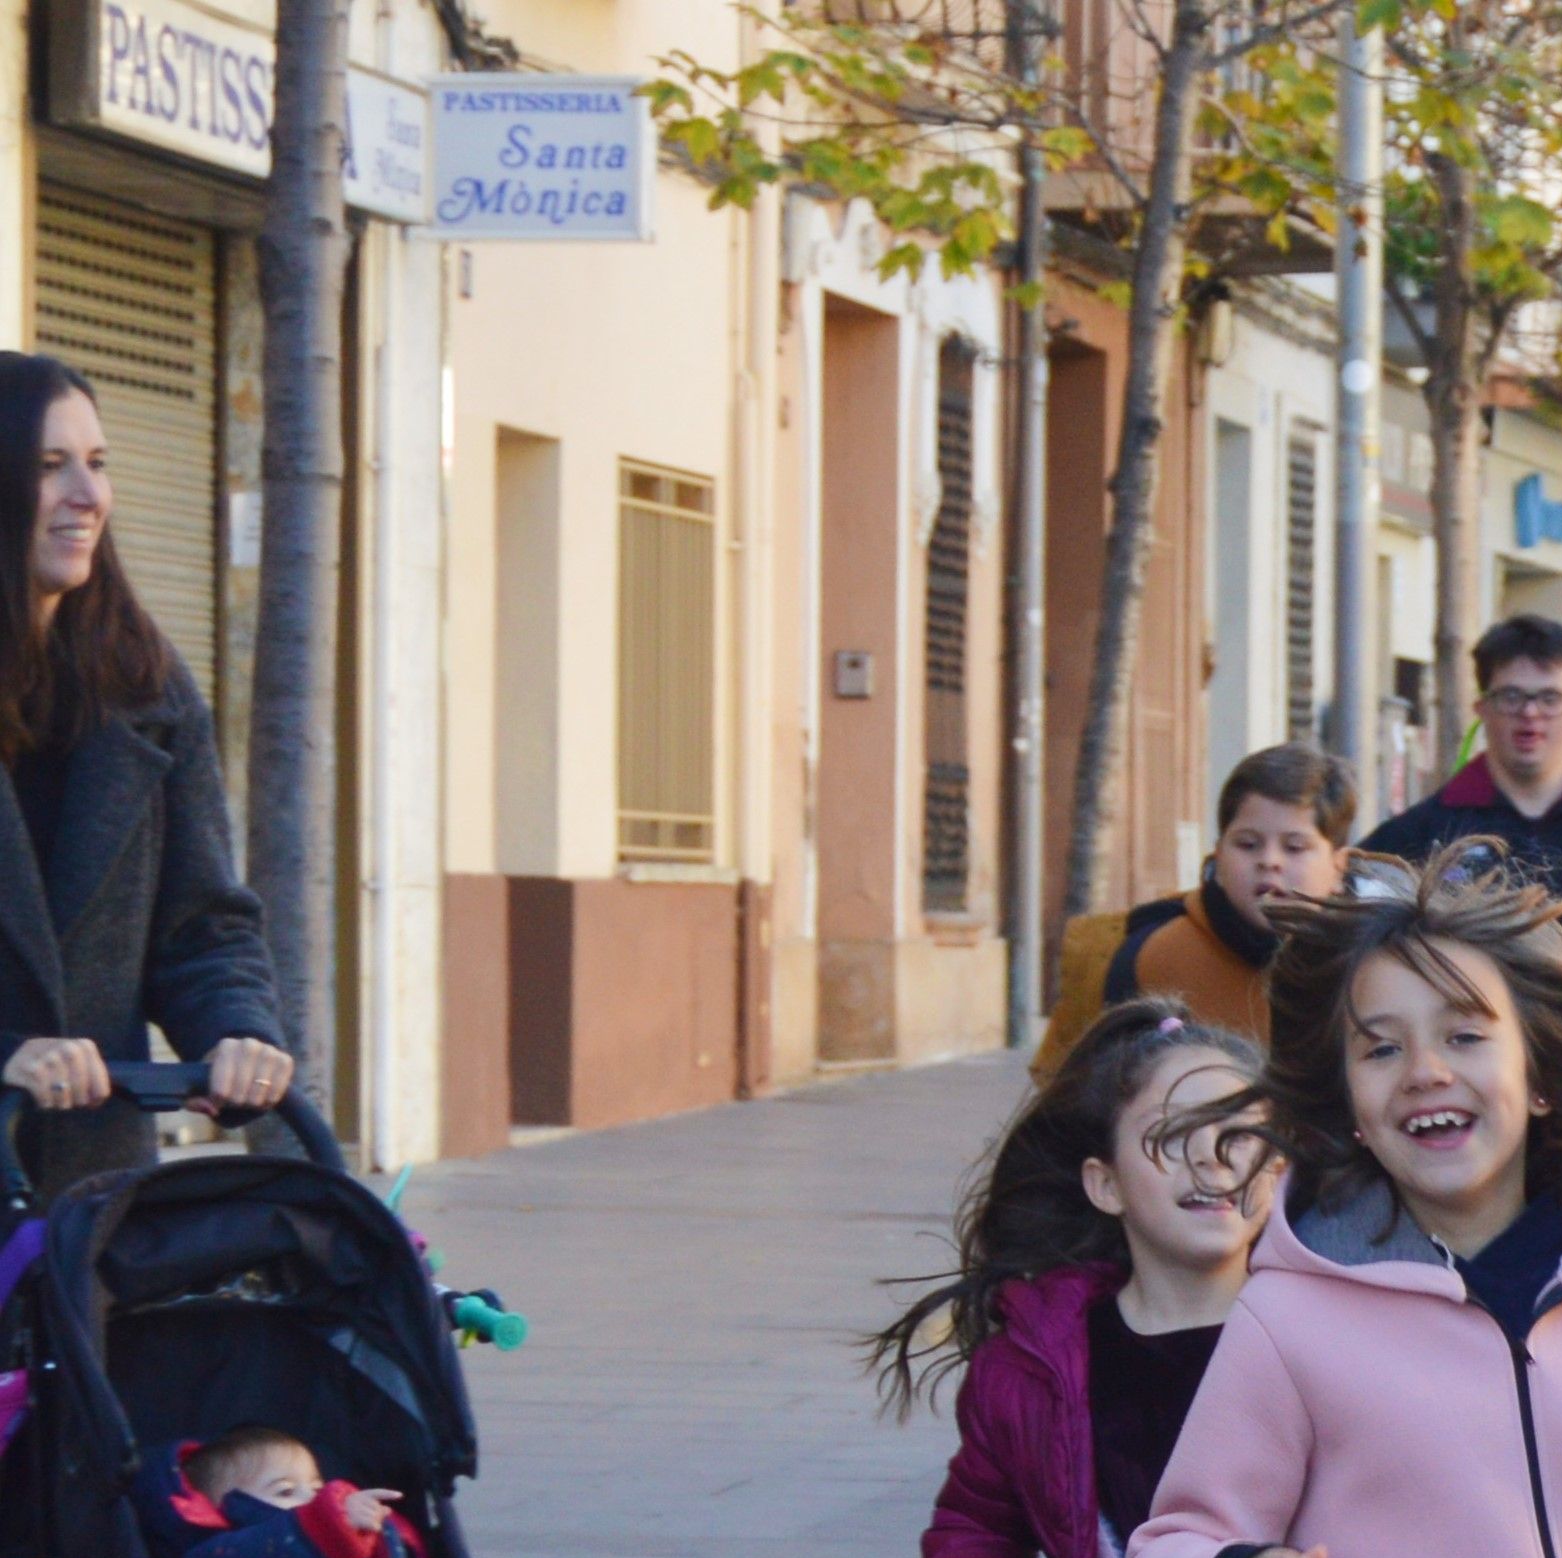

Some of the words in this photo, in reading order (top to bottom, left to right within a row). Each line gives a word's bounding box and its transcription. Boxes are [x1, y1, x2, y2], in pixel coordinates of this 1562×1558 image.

[442, 91, 622, 113] PASTISSERIA
[499, 123, 626, 169] Santa
[436, 176, 627, 225] Mònica
